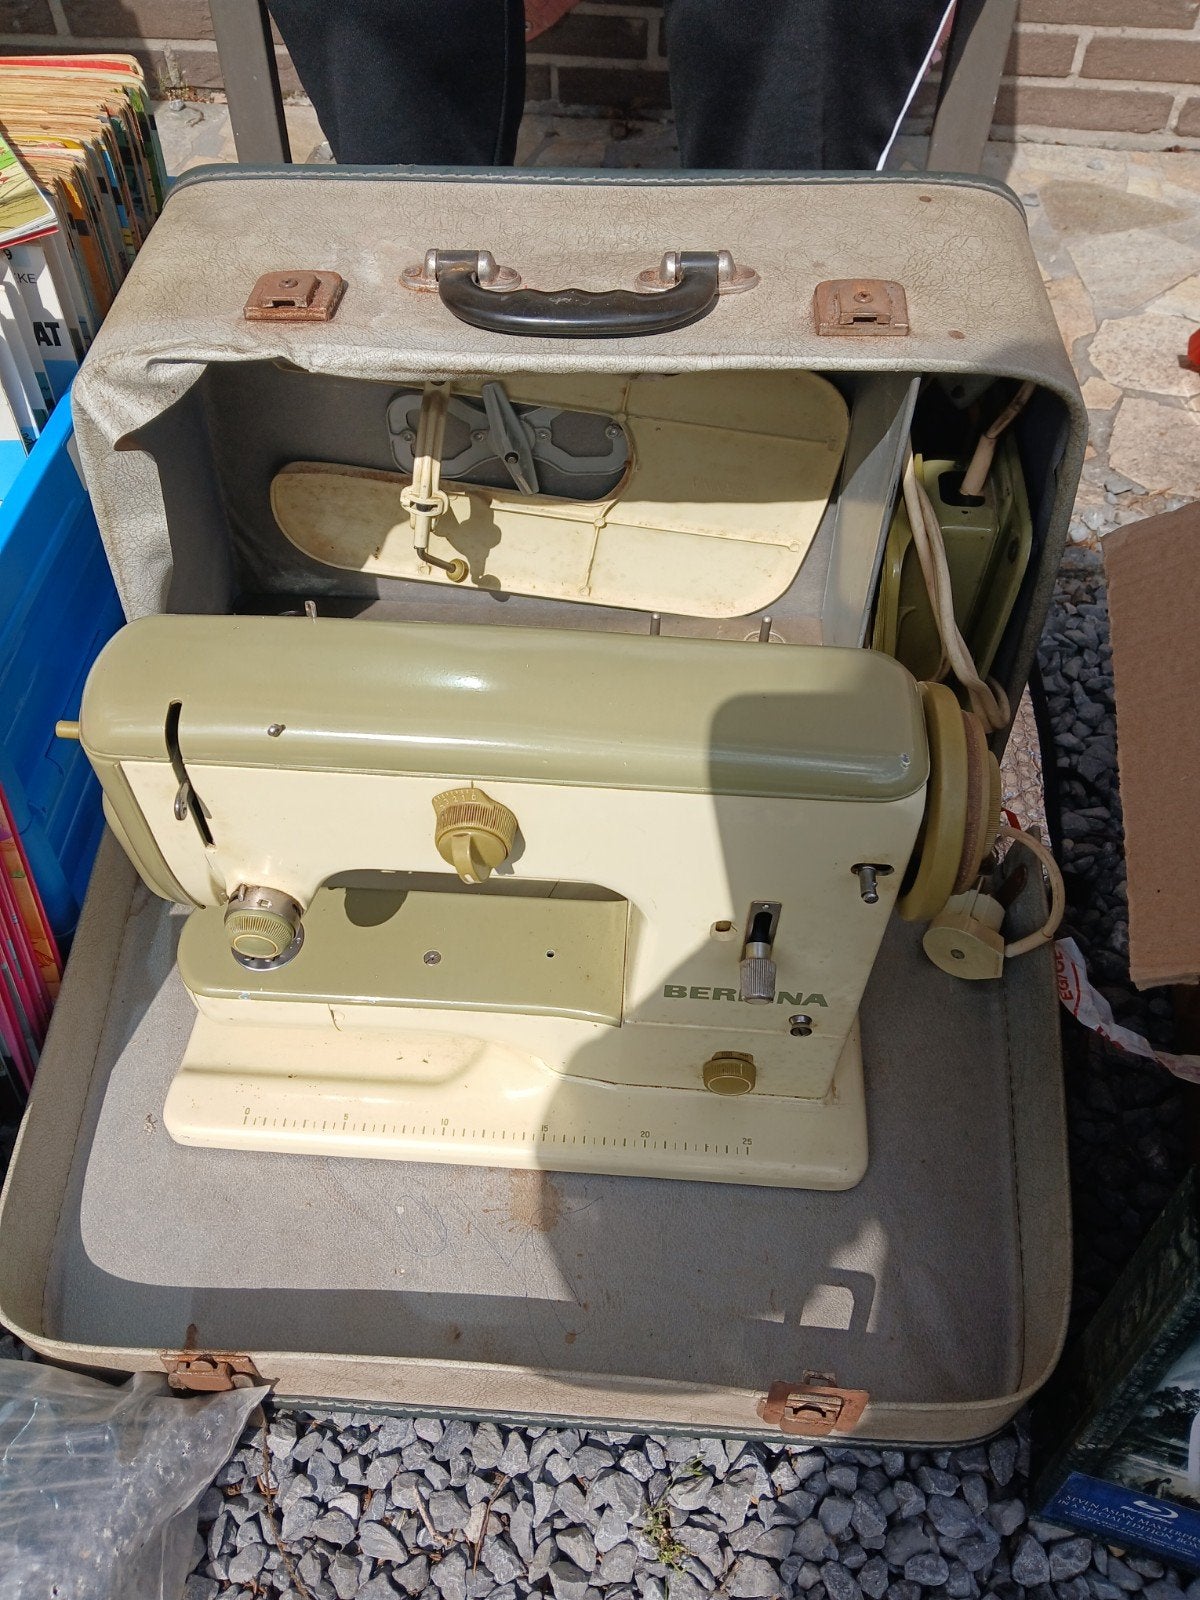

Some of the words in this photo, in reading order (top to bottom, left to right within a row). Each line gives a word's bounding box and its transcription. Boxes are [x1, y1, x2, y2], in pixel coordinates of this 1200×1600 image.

[663, 984, 829, 1007] BERNA
[244, 1107, 251, 1115] 0
[343, 1113, 349, 1121] 5
[440, 1118, 449, 1126] 10
[541, 1124, 549, 1132] 15
[640, 1130, 650, 1138] 20
[742, 1137, 753, 1146] 25
[1102, 1507, 1135, 1521] ASIAN
